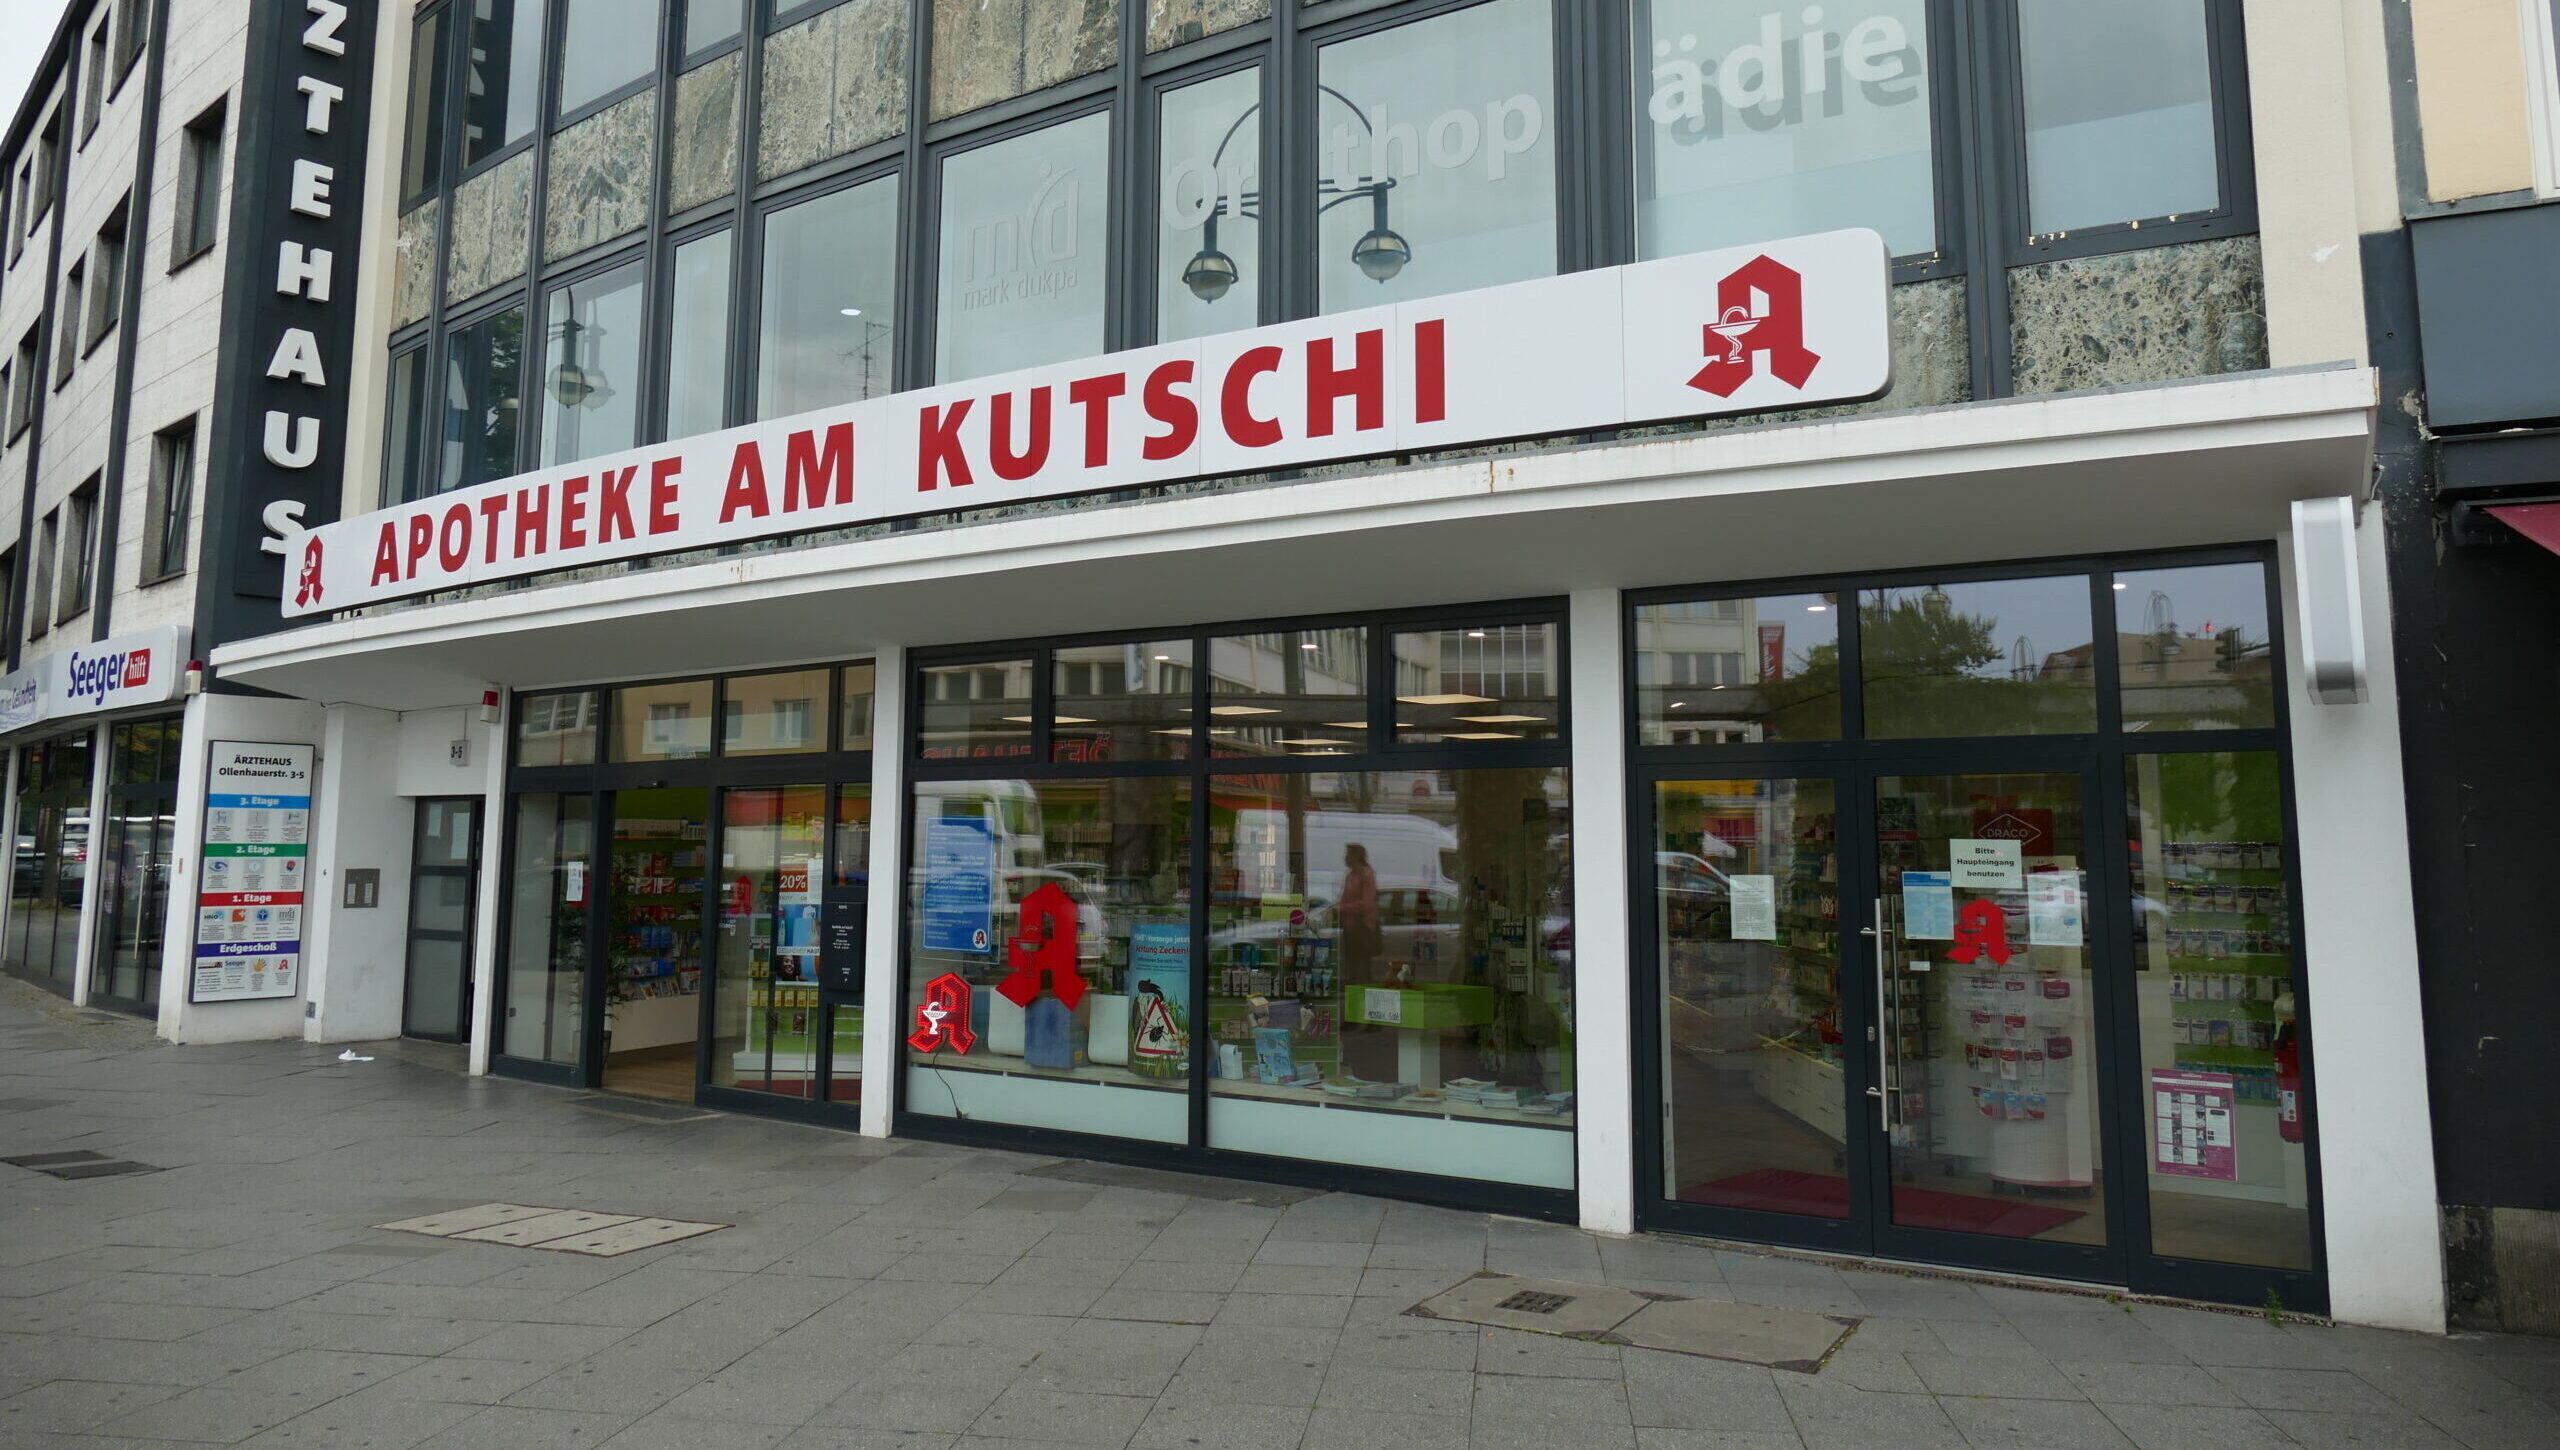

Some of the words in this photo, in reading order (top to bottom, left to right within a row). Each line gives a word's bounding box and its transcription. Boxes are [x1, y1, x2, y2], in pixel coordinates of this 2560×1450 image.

[963, 280, 1009, 311] mark
[1018, 269, 1078, 299] dukpa
[370, 455, 682, 587] APOTHEKE
[719, 421, 854, 523] AM
[917, 318, 1445, 493] KUTSCHI
[68, 652, 126, 705] Seeger
[129, 656, 147, 680] hilft
[451, 746, 463, 759] 3-5
[234, 755, 292, 766] ÄRZTEHAUS
[219, 767, 288, 778] Ollenhauerstr.
[290, 771, 305, 779] 3-5
[240, 797, 249, 805] 3.
[251, 797, 279, 807] Etage
[1987, 829, 2029, 838] DRACO
[236, 845, 245, 854] 2.
[247, 845, 276, 855] Etage
[1975, 847, 1995, 855] Bitte
[1957, 858, 2015, 867] Haupteingang
[1967, 870, 2005, 878] benutzen
[780, 875, 806, 889] 20%
[244, 894, 272, 904] Etage
[220, 942, 277, 954] Erdgeschoß
